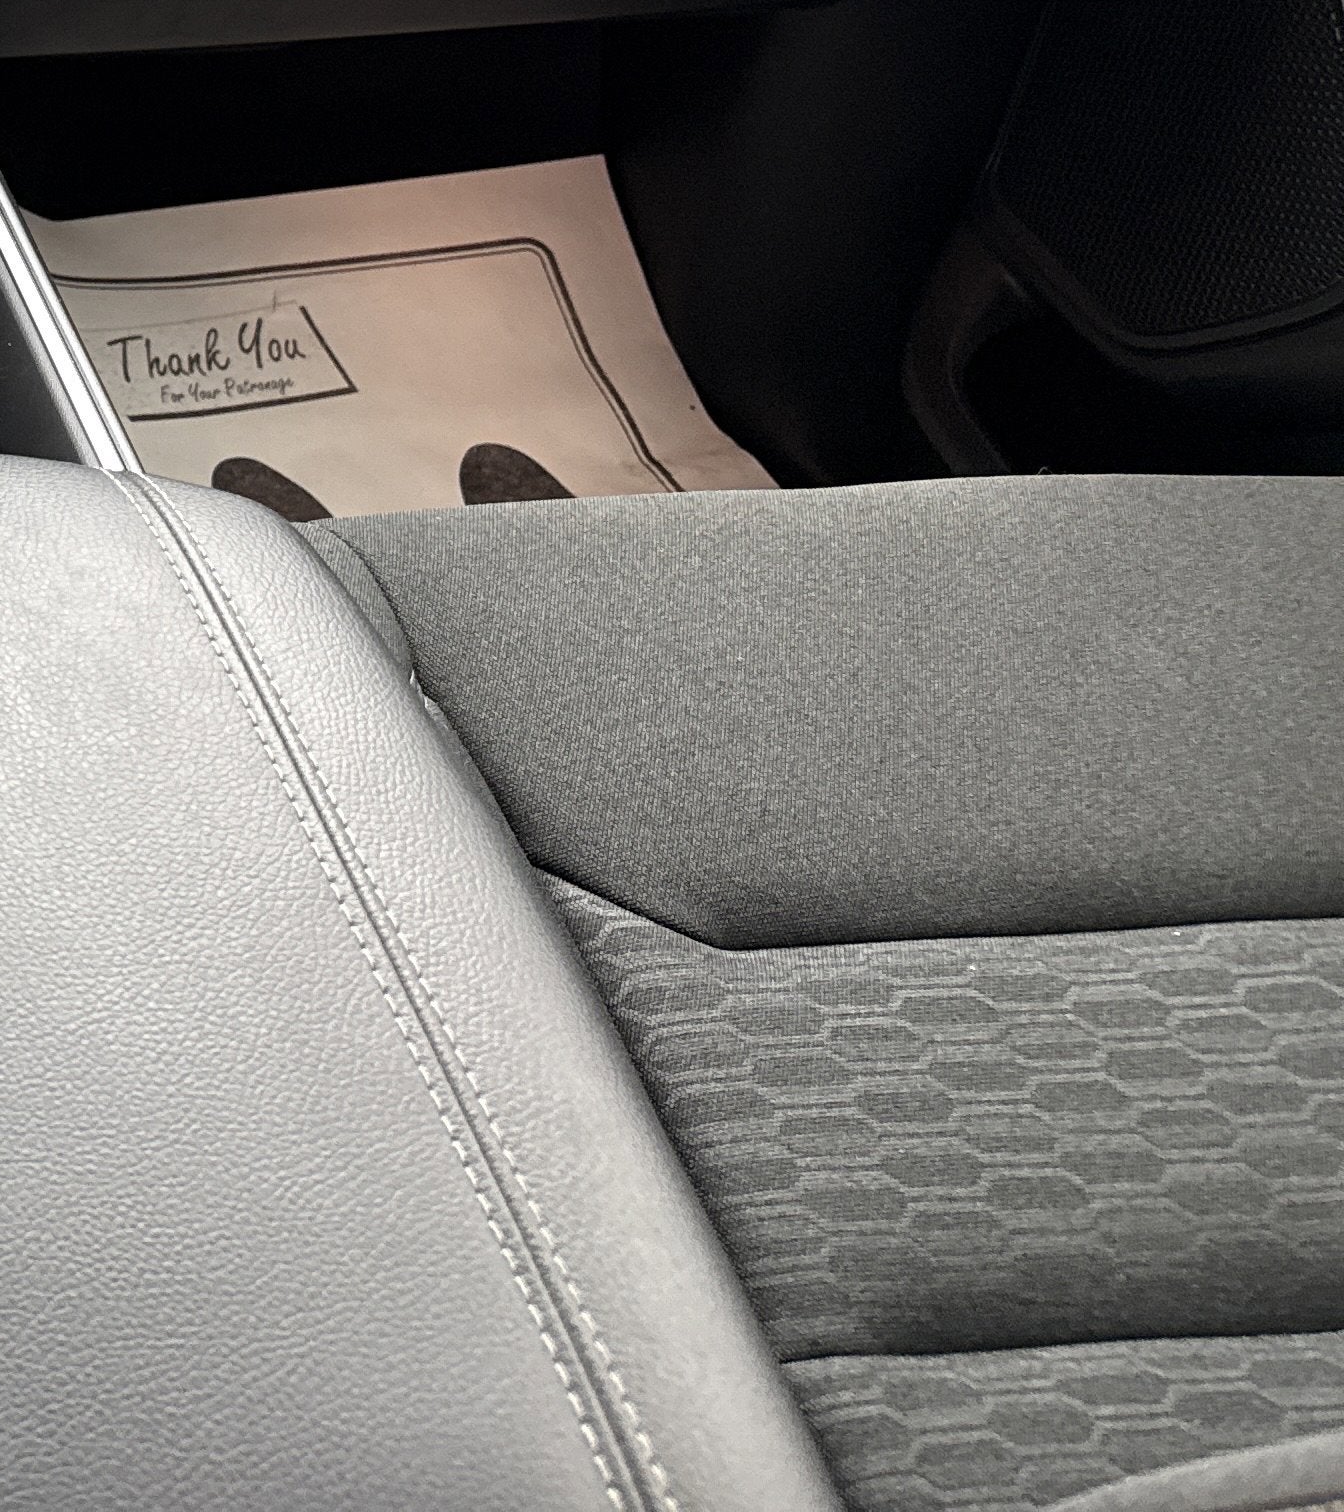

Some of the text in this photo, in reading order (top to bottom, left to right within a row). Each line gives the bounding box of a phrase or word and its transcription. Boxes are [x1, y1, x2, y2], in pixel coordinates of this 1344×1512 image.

[107, 317, 306, 384] Thank You
[161, 377, 295, 404] For Your Patronage
